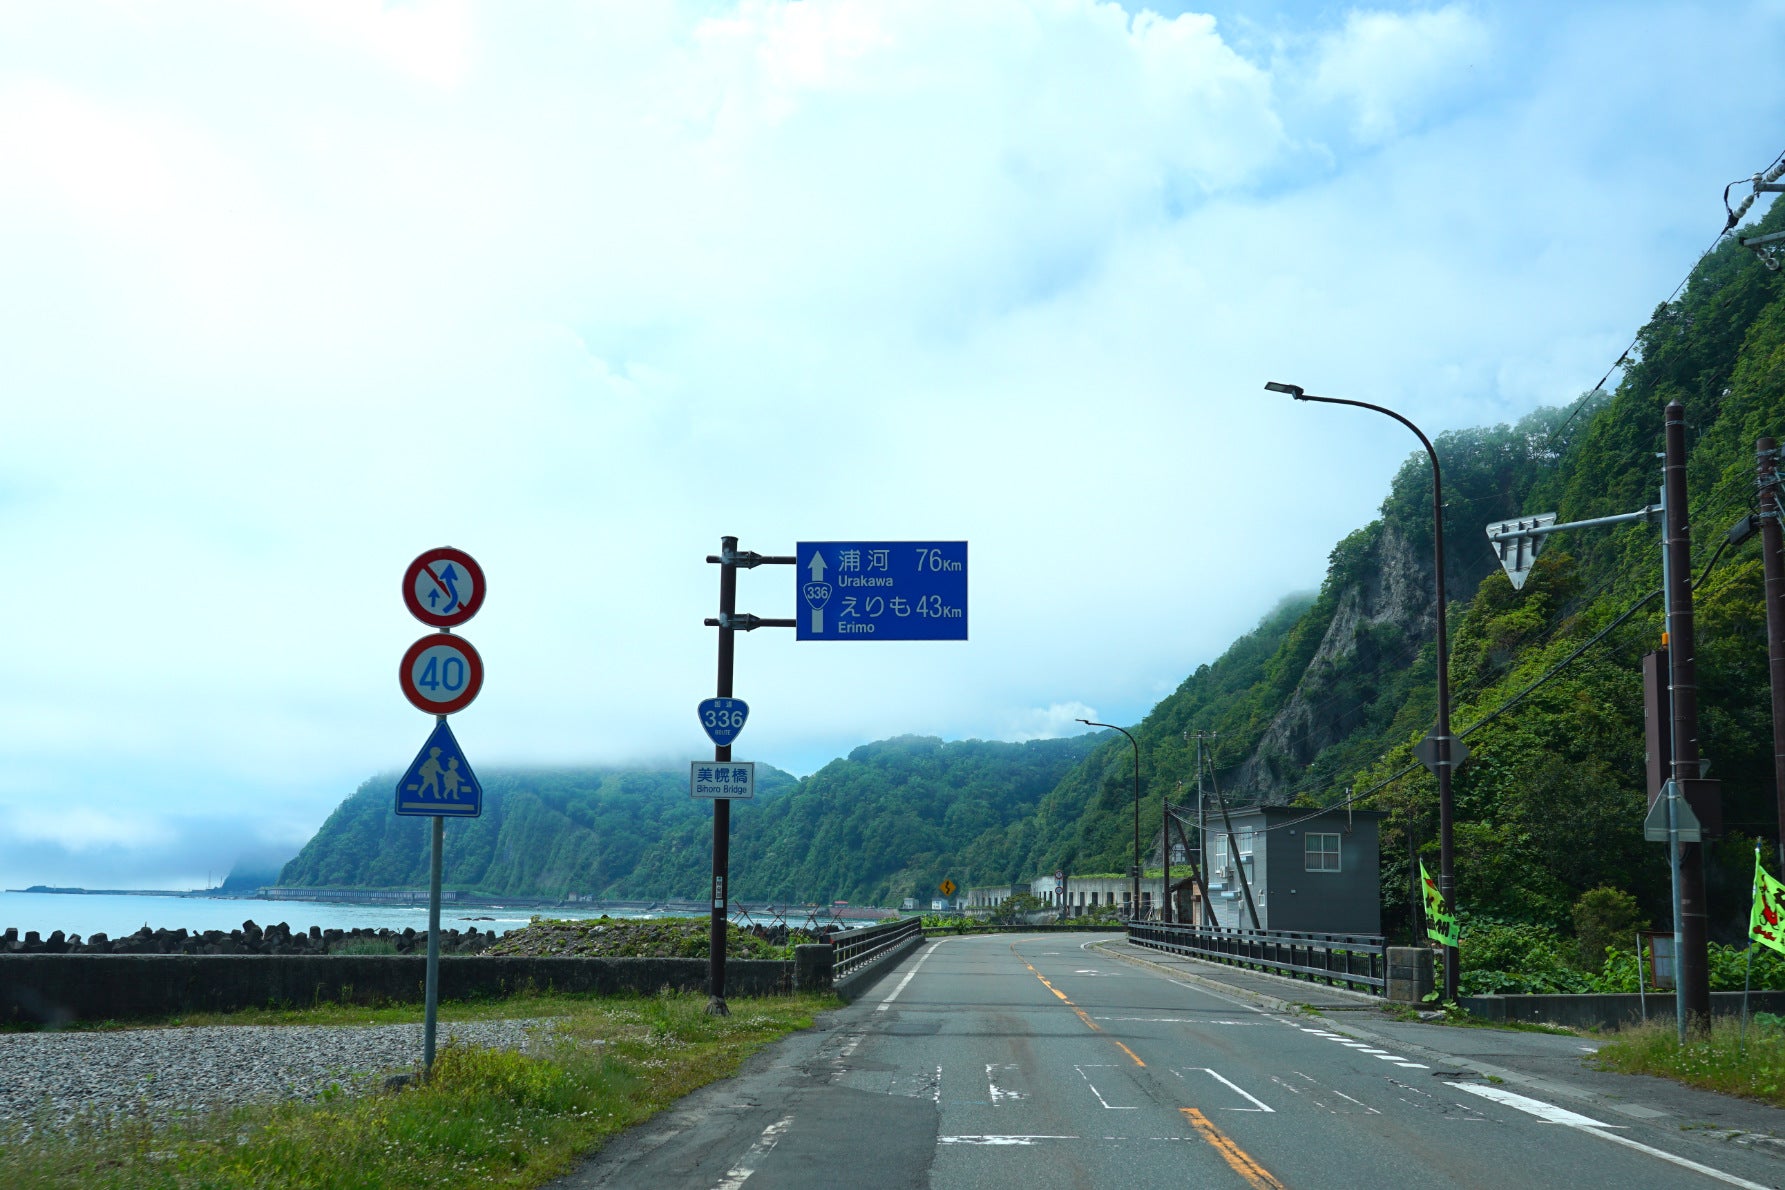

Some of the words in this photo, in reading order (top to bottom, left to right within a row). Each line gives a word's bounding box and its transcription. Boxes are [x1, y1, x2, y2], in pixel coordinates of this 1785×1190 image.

[838, 549, 890, 572] 浦河
[838, 575, 893, 587] Urakawa
[807, 586, 828, 599] 336
[840, 596, 911, 618] えりも
[838, 621, 875, 633] Erimo
[419, 656, 464, 691] 40
[704, 710, 743, 728] 336
[697, 767, 748, 783] 美幌橋
[696, 784, 721, 793] Bihoro
[723, 784, 748, 795] Bridge
